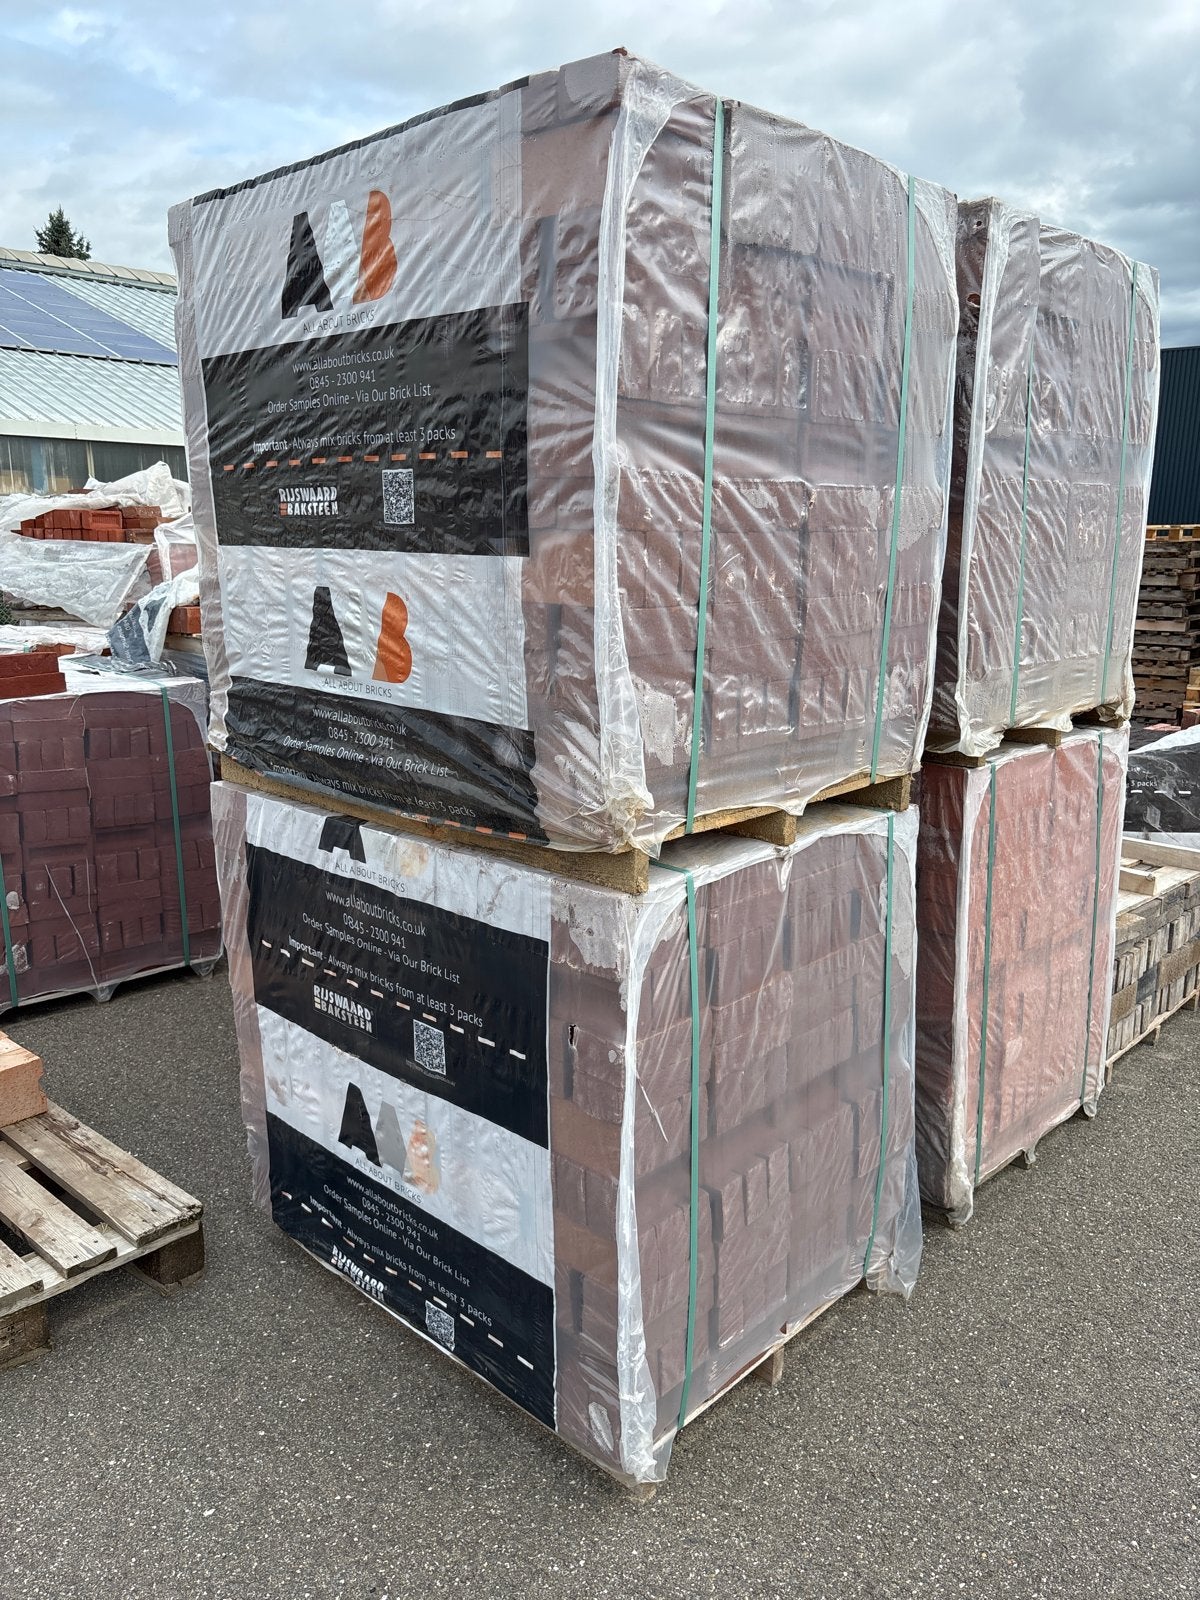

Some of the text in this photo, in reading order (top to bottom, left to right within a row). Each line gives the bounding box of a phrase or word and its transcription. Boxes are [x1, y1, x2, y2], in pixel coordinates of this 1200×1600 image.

[303, 309, 376, 334] ALL ABOUT BRICKS
[293, 345, 395, 374] www.allaboutbricks.co.uk
[310, 375, 330, 390] 0845
[337, 371, 358, 386] 2300
[360, 369, 376, 383] 941
[267, 401, 288, 414] Order
[289, 398, 321, 413] Samples
[323, 393, 350, 407] Online
[356, 390, 369, 403] Via
[372, 389, 388, 402] Our
[390, 385, 411, 400] Brick
[414, 383, 432, 397] List
[253, 440, 288, 454] Important
[293, 438, 319, 450] Always
[320, 434, 335, 447] mix
[337, 432, 361, 446] bricks
[364, 431, 383, 445] from
[386, 434, 394, 444] at
[396, 431, 418, 443] least
[420, 427, 426, 442] 3
[427, 426, 456, 444] packs
[279, 487, 338, 502] RIJSWAARD
[287, 501, 339, 516] BAKSTEEN
[324, 678, 393, 699] ALL ABOUT BRICKS
[328, 727, 349, 742] 0845
[354, 731, 377, 747] 2300
[379, 736, 394, 750] 941
[283, 736, 304, 750] Order
[305, 741, 336, 758] Samples
[337, 747, 365, 763] Online
[370, 754, 383, 766] Via
[386, 757, 402, 769] Our
[405, 759, 427, 774] Brick
[431, 763, 449, 778] List
[342, 780, 358, 792] mix
[415, 797, 440, 811] least
[440, 802, 447, 812] 3
[448, 805, 476, 818] packs
[1137, 780, 1158, 788] packs
[335, 862, 348, 874] ALL
[350, 866, 377, 880] ABOUT
[326, 891, 427, 937] www.allaboutbricks.co.uk
[343, 913, 365, 935] 0845
[371, 925, 389, 944] 2300
[391, 933, 406, 949] 941
[302, 913, 323, 932] Order
[325, 922, 356, 945] Samples
[357, 938, 383, 956] Online
[388, 949, 401, 963] Via
[403, 954, 418, 969] Our
[420, 960, 442, 977] Brick
[444, 968, 461, 985] List
[288, 935, 324, 961] Important
[328, 955, 354, 974] Always
[355, 967, 369, 980] mix
[370, 971, 394, 992] bricks
[396, 982, 415, 1001] from
[417, 993, 425, 1006] at
[427, 994, 448, 1014] least
[450, 1004, 455, 1016] 3
[458, 1010, 484, 1028] packs
[314, 984, 372, 1021] RIJSWAARD
[321, 1001, 373, 1034] BAKSTEEN
[355, 1158, 423, 1204] ALL ABOUT BRICKS
[346, 1176, 439, 1241] www.allaboutbricks.co.uk
[362, 1196, 380, 1217] 0845
[386, 1213, 405, 1231] 2300
[407, 1226, 422, 1242] 941
[323, 1184, 343, 1203] Order
[343, 1198, 372, 1226] Samples
[373, 1219, 398, 1240] Online
[403, 1235, 415, 1251] Via
[416, 1245, 432, 1261] Our
[433, 1256, 453, 1276] Brick
[455, 1270, 471, 1287] List
[371, 1244, 385, 1257] mix
[385, 1250, 407, 1271] bricks
[408, 1265, 427, 1283] from
[428, 1278, 437, 1290] at
[438, 1283, 458, 1304] least
[460, 1298, 466, 1308] 3
[468, 1304, 493, 1327] packs
